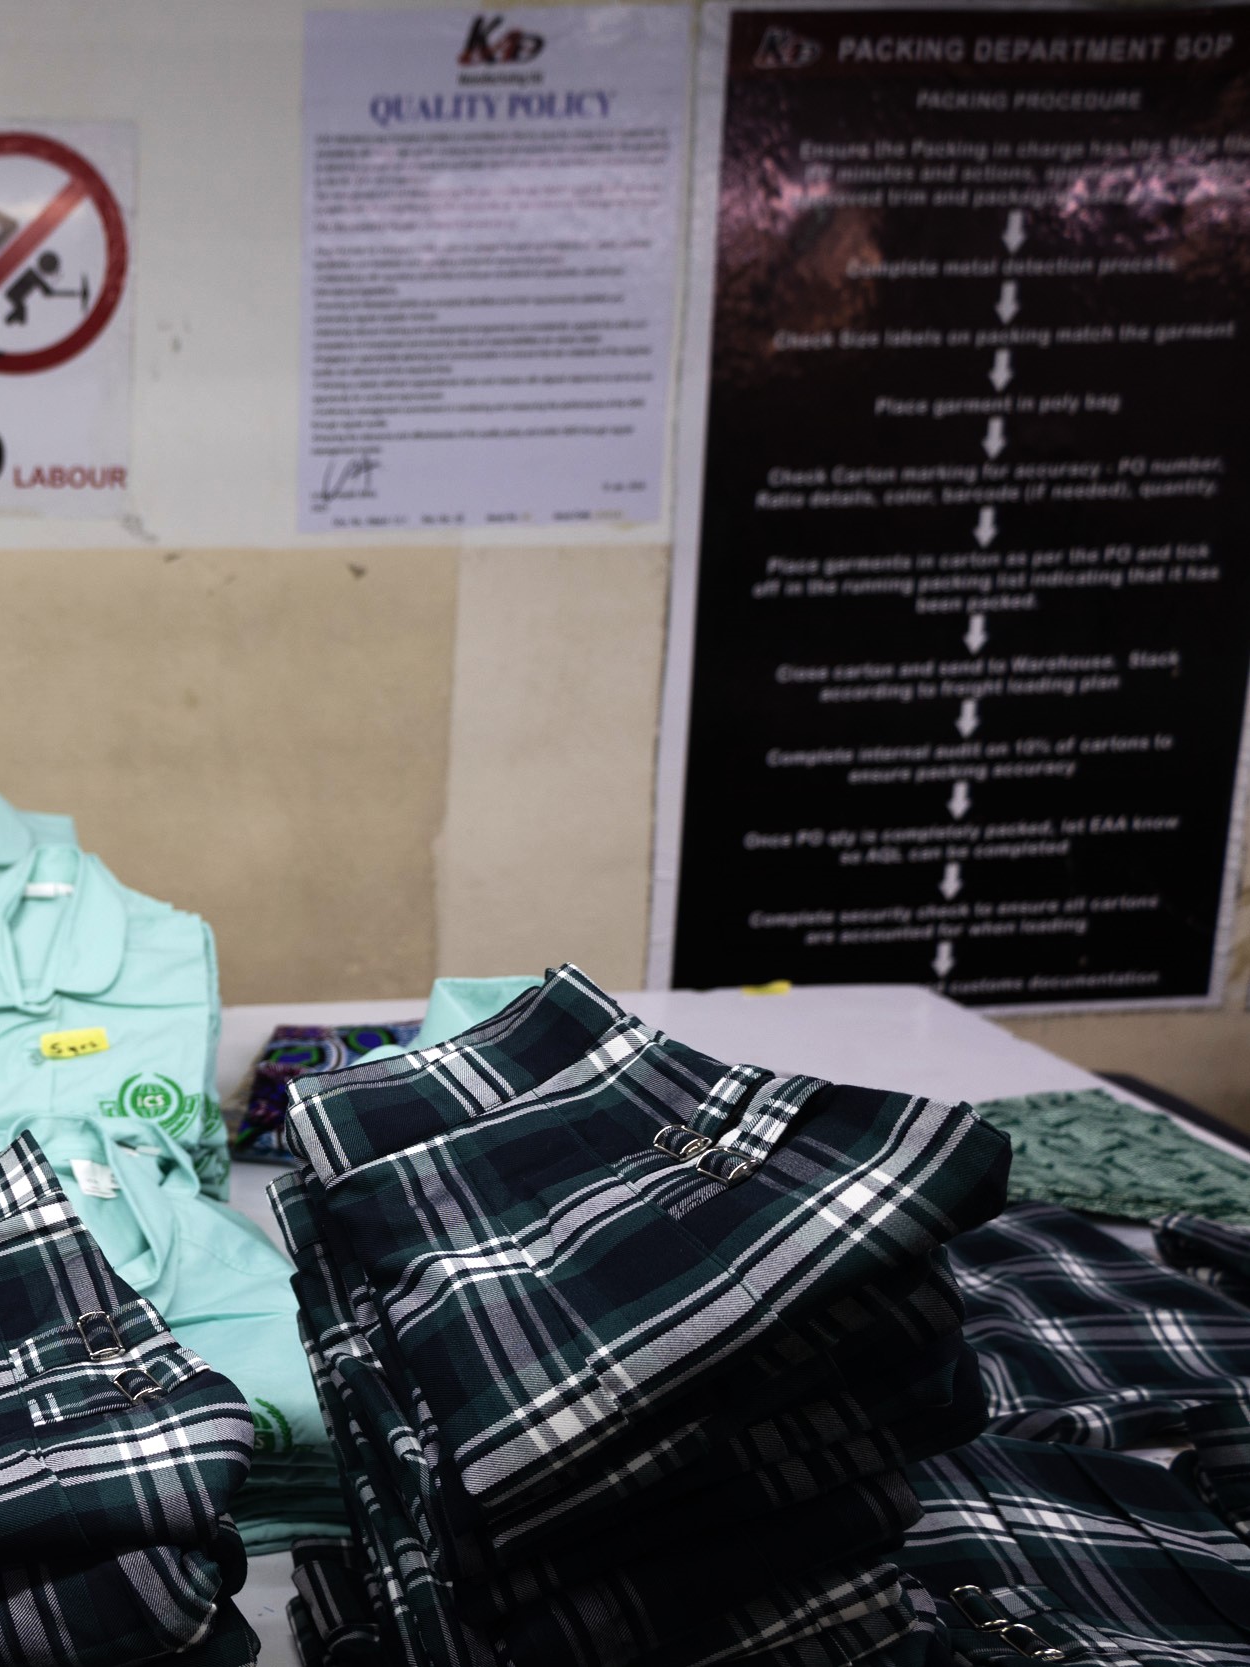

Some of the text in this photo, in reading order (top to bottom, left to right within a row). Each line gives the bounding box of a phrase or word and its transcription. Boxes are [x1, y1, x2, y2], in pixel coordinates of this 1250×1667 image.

[838, 37, 967, 62] PACKING
[973, 36, 1166, 62] DEPARTMENT
[1175, 33, 1233, 60] SOP
[370, 90, 615, 127] QUALITY POLICY
[916, 89, 1142, 110] PACKING PROCEDURE
[800, 140, 870, 160] Ensure
[874, 139, 907, 159] the
[910, 139, 988, 162] Packing
[992, 141, 1012, 158] in
[1016, 141, 1085, 161] charge
[919, 164, 957, 181] and
[932, 188, 970, 207] and
[846, 256, 1177, 279] Complete metal detection process
[774, 321, 1235, 350] Check Size labels on packing match the garment
[874, 393, 1121, 418] Place garment in poly bag
[13, 465, 128, 490] LABOUR
[767, 466, 827, 488] Check
[831, 464, 896, 485] Carton
[900, 463, 978, 484] marking
[982, 461, 1010, 480] for
[1014, 461, 1101, 481] accuracy
[1118, 455, 1148, 476] PO
[755, 489, 805, 510] Ratio
[942, 483, 1021, 504] barcode
[766, 542, 1210, 576] Place garments in carton as per the PO and tick
[752, 579, 780, 599] off
[807, 577, 838, 597] the
[841, 576, 914, 597] running
[918, 573, 992, 595] packing
[996, 571, 1026, 590] list
[1030, 567, 1123, 589] indicating
[1127, 565, 1165, 586] that
[1168, 564, 1184, 583] it
[1187, 562, 1220, 582] has
[915, 595, 964, 614] been
[775, 663, 828, 683] Close
[832, 661, 895, 681] carton
[898, 660, 935, 679] and
[938, 659, 984, 678] send
[987, 658, 1007, 676] to
[819, 674, 1120, 702] according to freight loading plan
[766, 734, 1174, 768] Complete internal audit on 10% of cartons to
[848, 760, 1076, 785] ensure packing accuracy
[743, 831, 791, 850] Once
[795, 829, 824, 846] PO
[827, 830, 856, 848] qty
[860, 830, 877, 843] is
[881, 824, 980, 845] completely
[1059, 816, 1085, 835] let
[1089, 815, 1127, 835] EAA
[1132, 813, 1179, 832] know
[839, 838, 1071, 866] so AQL can be completed
[748, 893, 1160, 930] Complete security check to ensure all cartons
[804, 916, 1087, 946] are accounted for when loading
[948, 978, 1024, 996] customs
[1028, 971, 1161, 992] documentation
